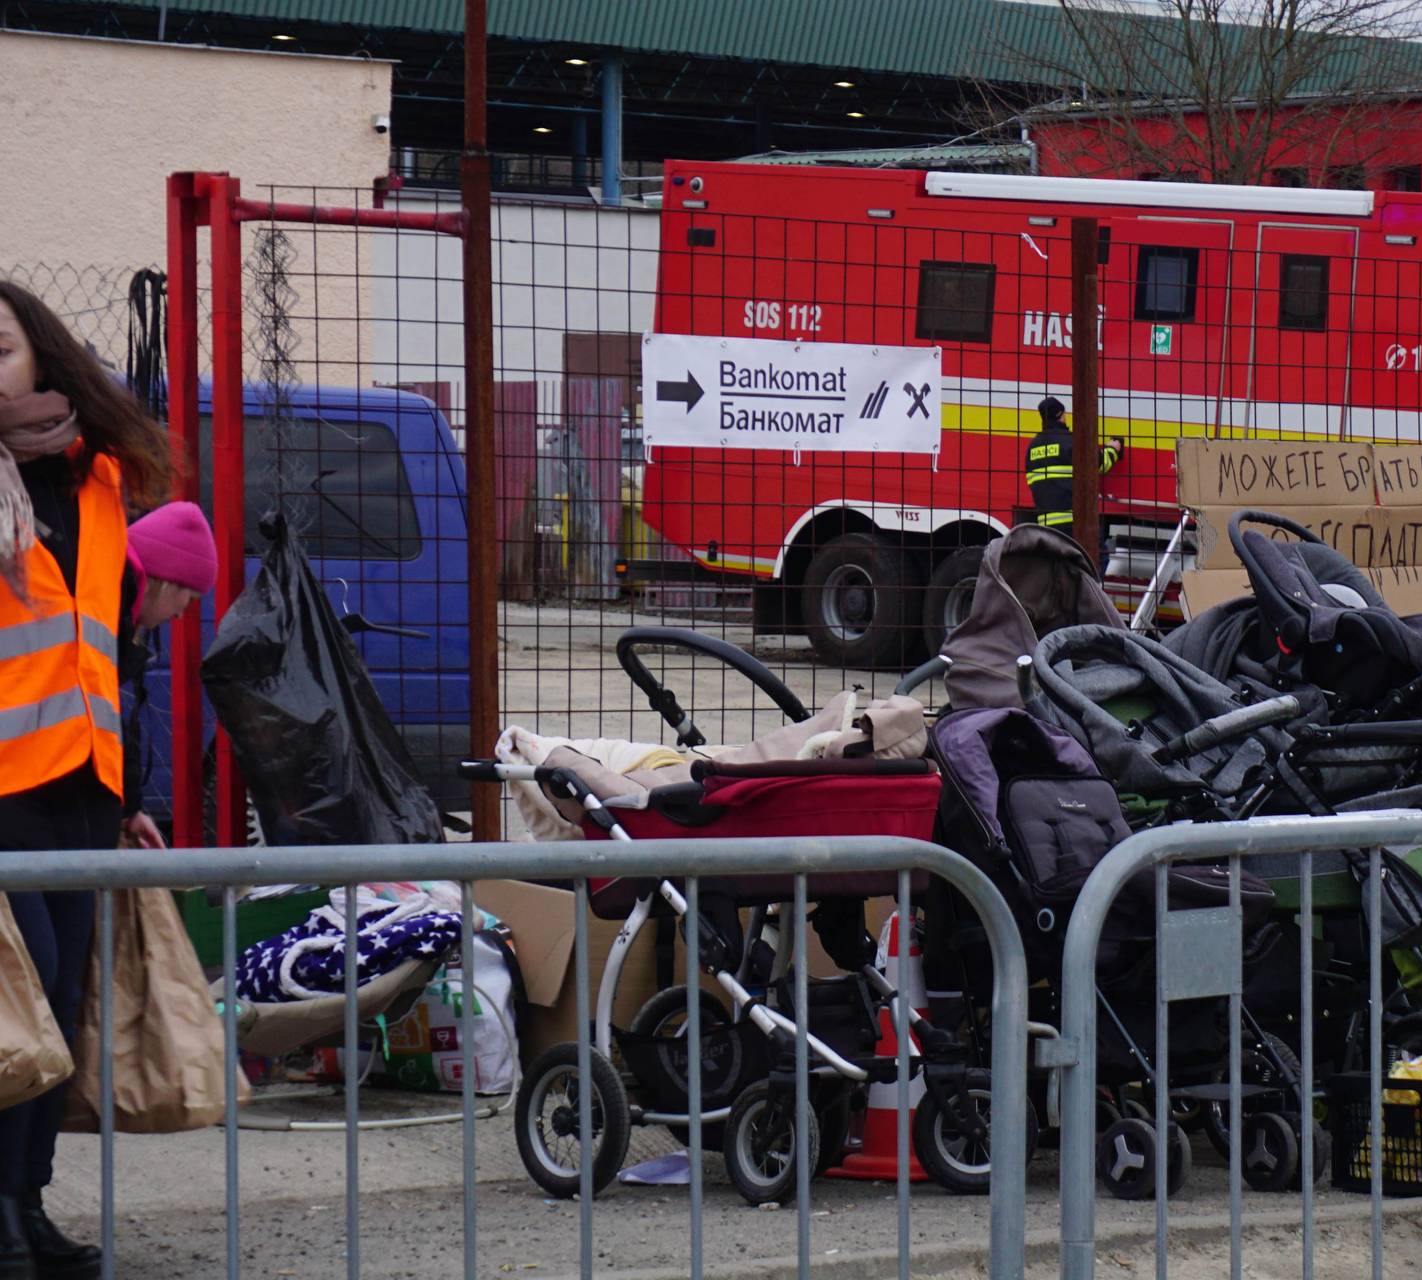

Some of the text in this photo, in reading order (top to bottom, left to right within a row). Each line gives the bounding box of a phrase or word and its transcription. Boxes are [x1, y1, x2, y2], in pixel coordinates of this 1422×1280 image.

[743, 300, 822, 331] SOS 112
[720, 360, 847, 392] Bankomat
[720, 401, 844, 434] Банкомат
[1218, 450, 1326, 497] МОЖЕТЕ
